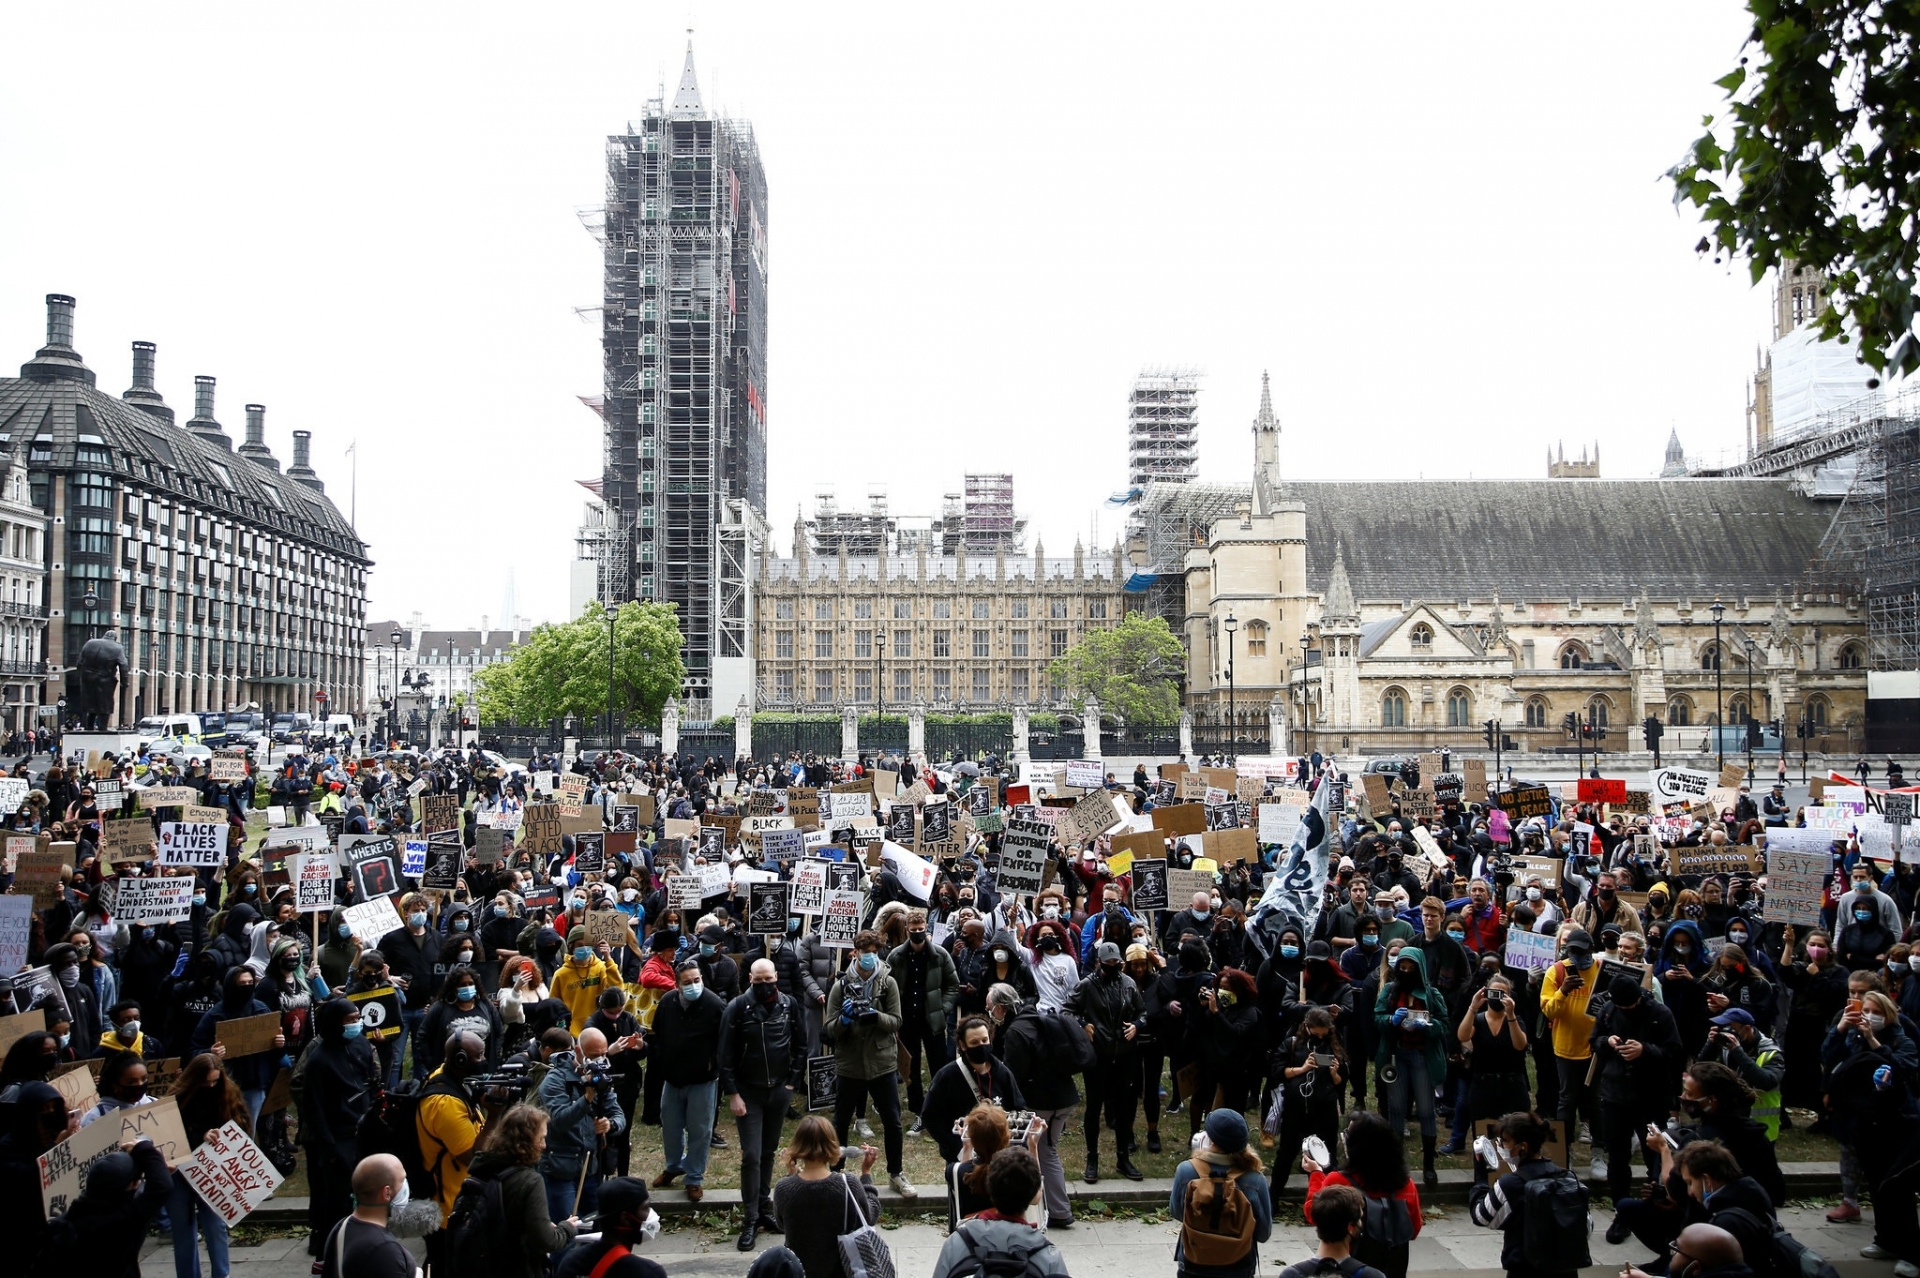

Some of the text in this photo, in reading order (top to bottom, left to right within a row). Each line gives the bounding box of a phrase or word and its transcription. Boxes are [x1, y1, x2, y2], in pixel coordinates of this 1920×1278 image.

[214, 751, 244, 760] STANDING
[1463, 760, 1485, 770] FUCK
[562, 775, 588, 785] WHITE
[1667, 771, 1708, 786] NO JUSTICE
[100, 782, 119, 792] BLM
[561, 783, 585, 793] SILENCE
[1464, 783, 1485, 792] FUCK
[1669, 782, 1706, 795] NO PEACE
[755, 791, 776, 799] BLACK
[789, 791, 797, 800] NO
[1401, 791, 1429, 801] BLACK
[1501, 789, 1548, 804] NO JUSTICE
[425, 797, 456, 807] WHITE
[1068, 789, 1105, 817] IGNORANCE
[1610, 803, 1650, 811] MATTER
[1885, 801, 1911, 809] BLACK
[190, 809, 221, 821] enough
[426, 807, 459, 818] PEOPLE
[524, 805, 560, 821] YOUNG
[560, 807, 581, 816] EATHS
[790, 806, 799, 814] NO
[1403, 807, 1433, 816] MATTER
[1504, 802, 1550, 819] NO PEACE
[1808, 809, 1852, 819] BLACK
[705, 816, 739, 825] BLACK
[1077, 803, 1110, 829] COLOUR
[1094, 810, 1114, 830] NOT
[1884, 816, 1912, 825] MATTER
[525, 821, 562, 838] GIFTED
[753, 820, 782, 830] BLACK
[1009, 819, 1050, 836] RESPECT
[1814, 820, 1847, 829] LIVES
[175, 824, 217, 836] BLACK
[173, 837, 216, 848] LIVES
[805, 835, 821, 843] BLACK
[1005, 834, 1048, 849] EXISTENCE
[349, 840, 394, 861] WHERE IS
[527, 838, 561, 854] BLACK
[166, 850, 220, 862] MATTER
[770, 852, 798, 860] BETRAYAL
[1017, 849, 1032, 859] OR
[1678, 846, 1738, 857] HIS NAME WAS
[1003, 857, 1043, 872] EXPECT
[1679, 862, 1750, 874] GEORGE FLOYD
[1777, 856, 1811, 875] SAY
[301, 871, 331, 880] RACISM!
[697, 867, 719, 876] BLACK
[800, 871, 820, 879] SMASH
[121, 880, 192, 890] I UNDERSTAND
[303, 880, 322, 888] JOBS
[798, 877, 822, 886] RACISM!
[1772, 877, 1814, 894] THEIR
[302, 888, 330, 896] HOMES
[797, 891, 820, 900] HOMES
[300, 896, 316, 904] FOR
[831, 900, 857, 908] SMASH
[1769, 898, 1813, 912] NAMES
[139, 907, 164, 918] STAND
[164, 907, 179, 917] WITH
[347, 899, 393, 923] SILENCE
[828, 907, 858, 916] RACISM!
[13, 917, 30, 929] YOU
[590, 914, 619, 927] BLACK
[590, 927, 615, 935] LIVES
[827, 923, 856, 932] HOMES
[593, 933, 623, 942] MATTER
[825, 931, 839, 939] FOR
[1509, 931, 1554, 950] SILENCE
[1507, 953, 1555, 970] VIOLENCE
[121, 1111, 159, 1136] AM
[39, 1140, 71, 1169] BLACK
[223, 1125, 274, 1188] IF YOU are
[42, 1152, 72, 1179] LIVES
[209, 1138, 260, 1190] NOT ANGRY
[43, 1157, 78, 1190] MATTER
[185, 1165, 238, 1220] ATTENTION
[213, 1172, 232, 1188] NOT
[230, 1188, 252, 1212] PAYING
